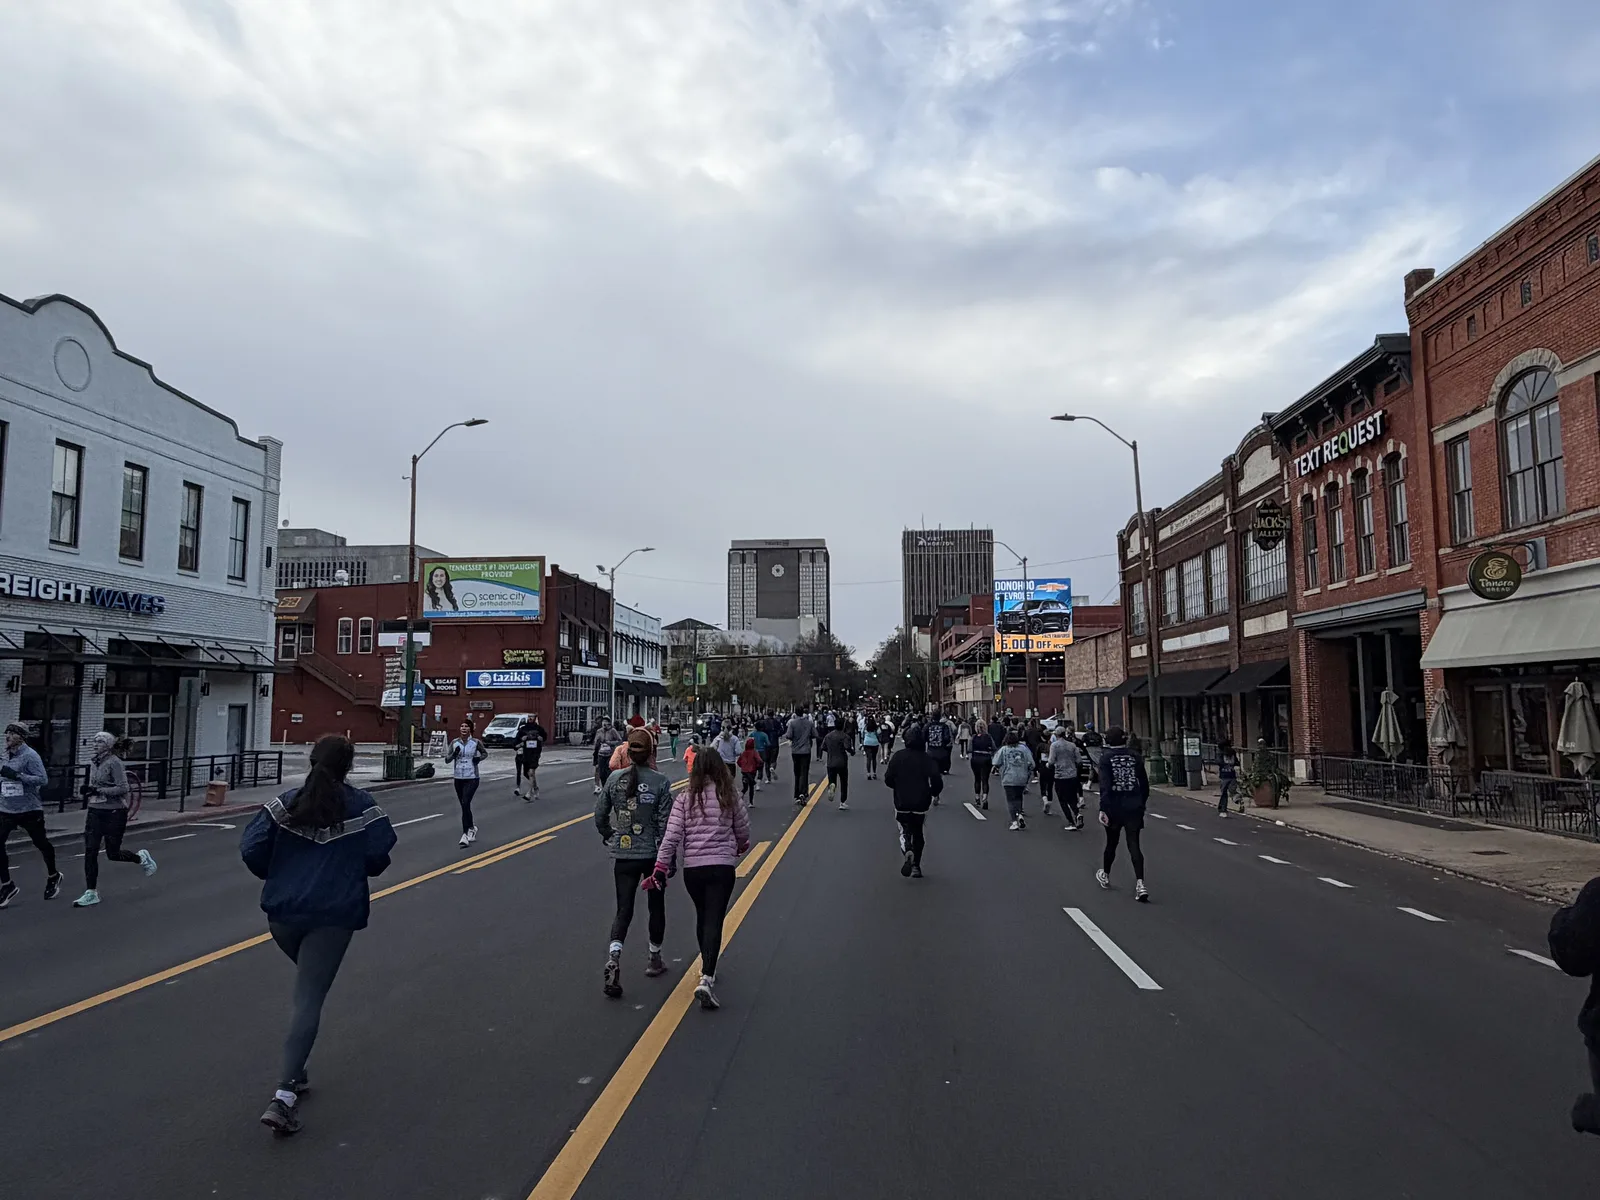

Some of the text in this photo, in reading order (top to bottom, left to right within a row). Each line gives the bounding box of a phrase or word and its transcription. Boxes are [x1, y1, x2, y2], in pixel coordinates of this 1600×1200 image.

[1294, 410, 1383, 478] TEXT REQUEST
[479, 592, 526, 602] scenic city
[995, 592, 1034, 600] CEVROLET
[1036, 640, 1052, 649] OFF
[493, 672, 531, 682] tazikis
